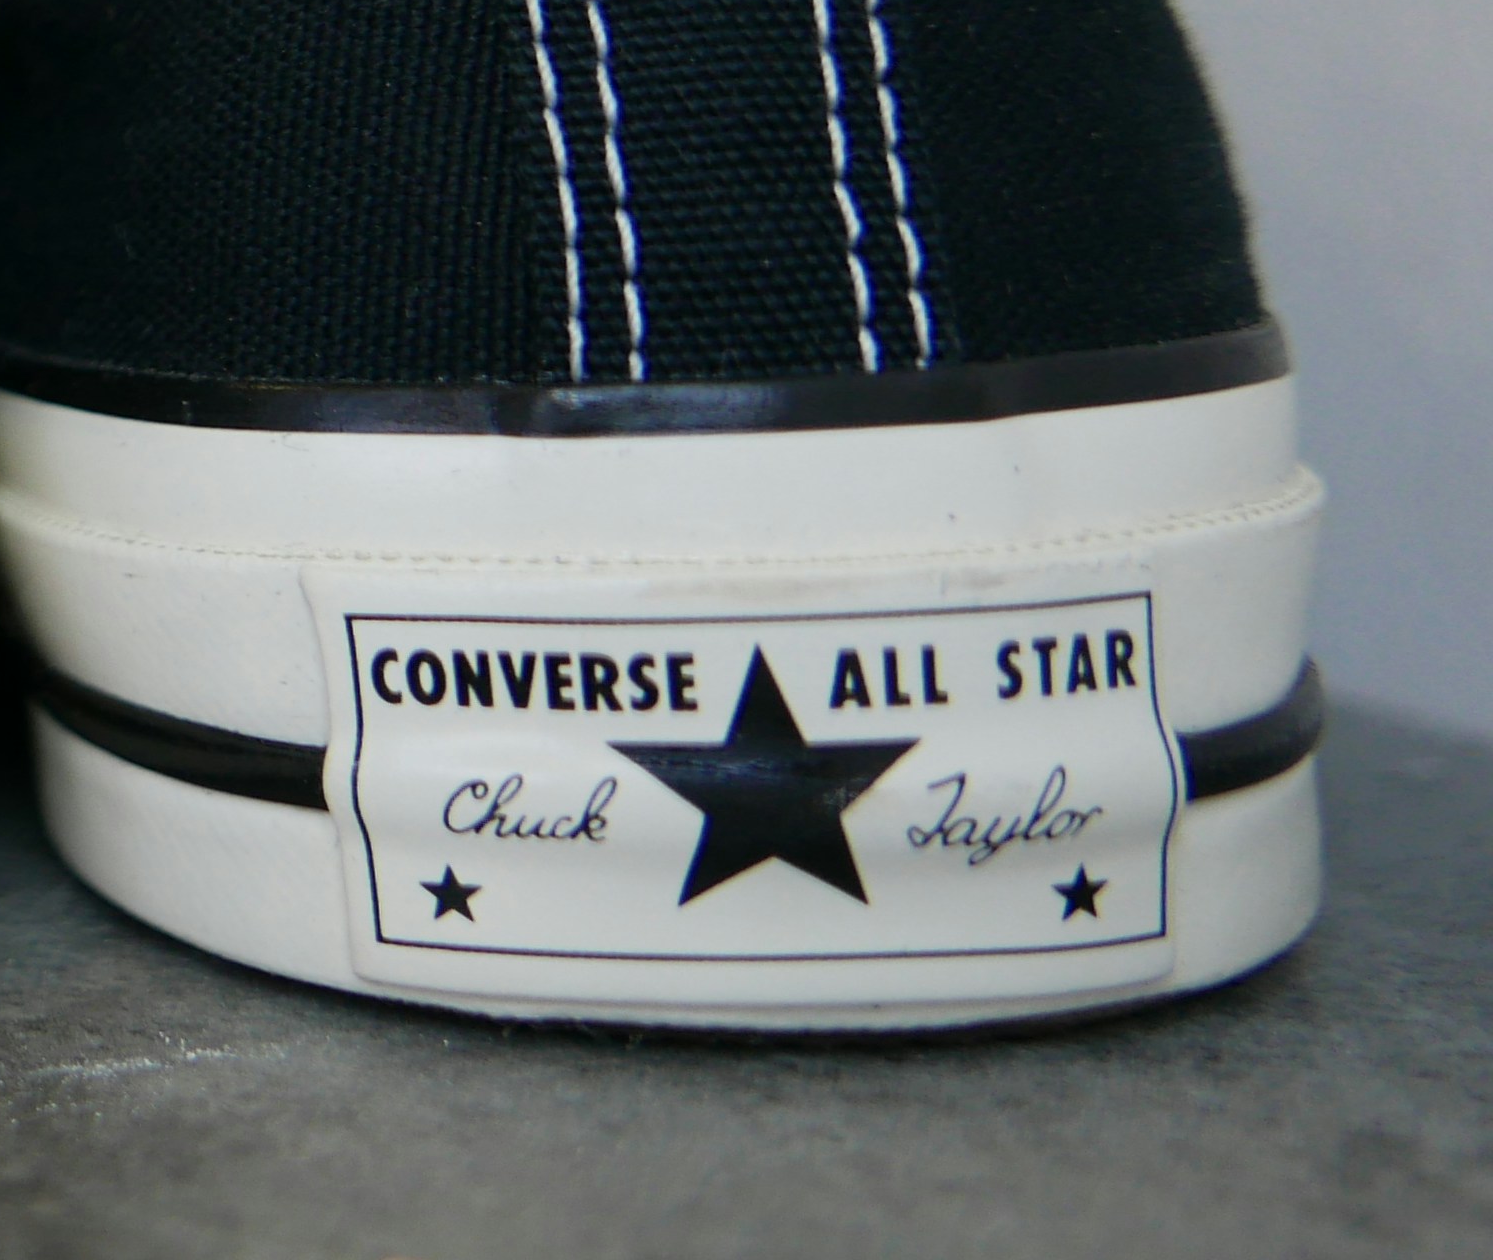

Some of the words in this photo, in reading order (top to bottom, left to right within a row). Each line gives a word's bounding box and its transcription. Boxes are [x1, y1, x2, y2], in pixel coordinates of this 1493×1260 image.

[369, 646, 700, 713] CONVERSE
[828, 643, 950, 710] ALL
[995, 628, 1138, 701] STAR
[441, 773, 619, 844] Chuck
[906, 764, 1105, 866] Taylor
